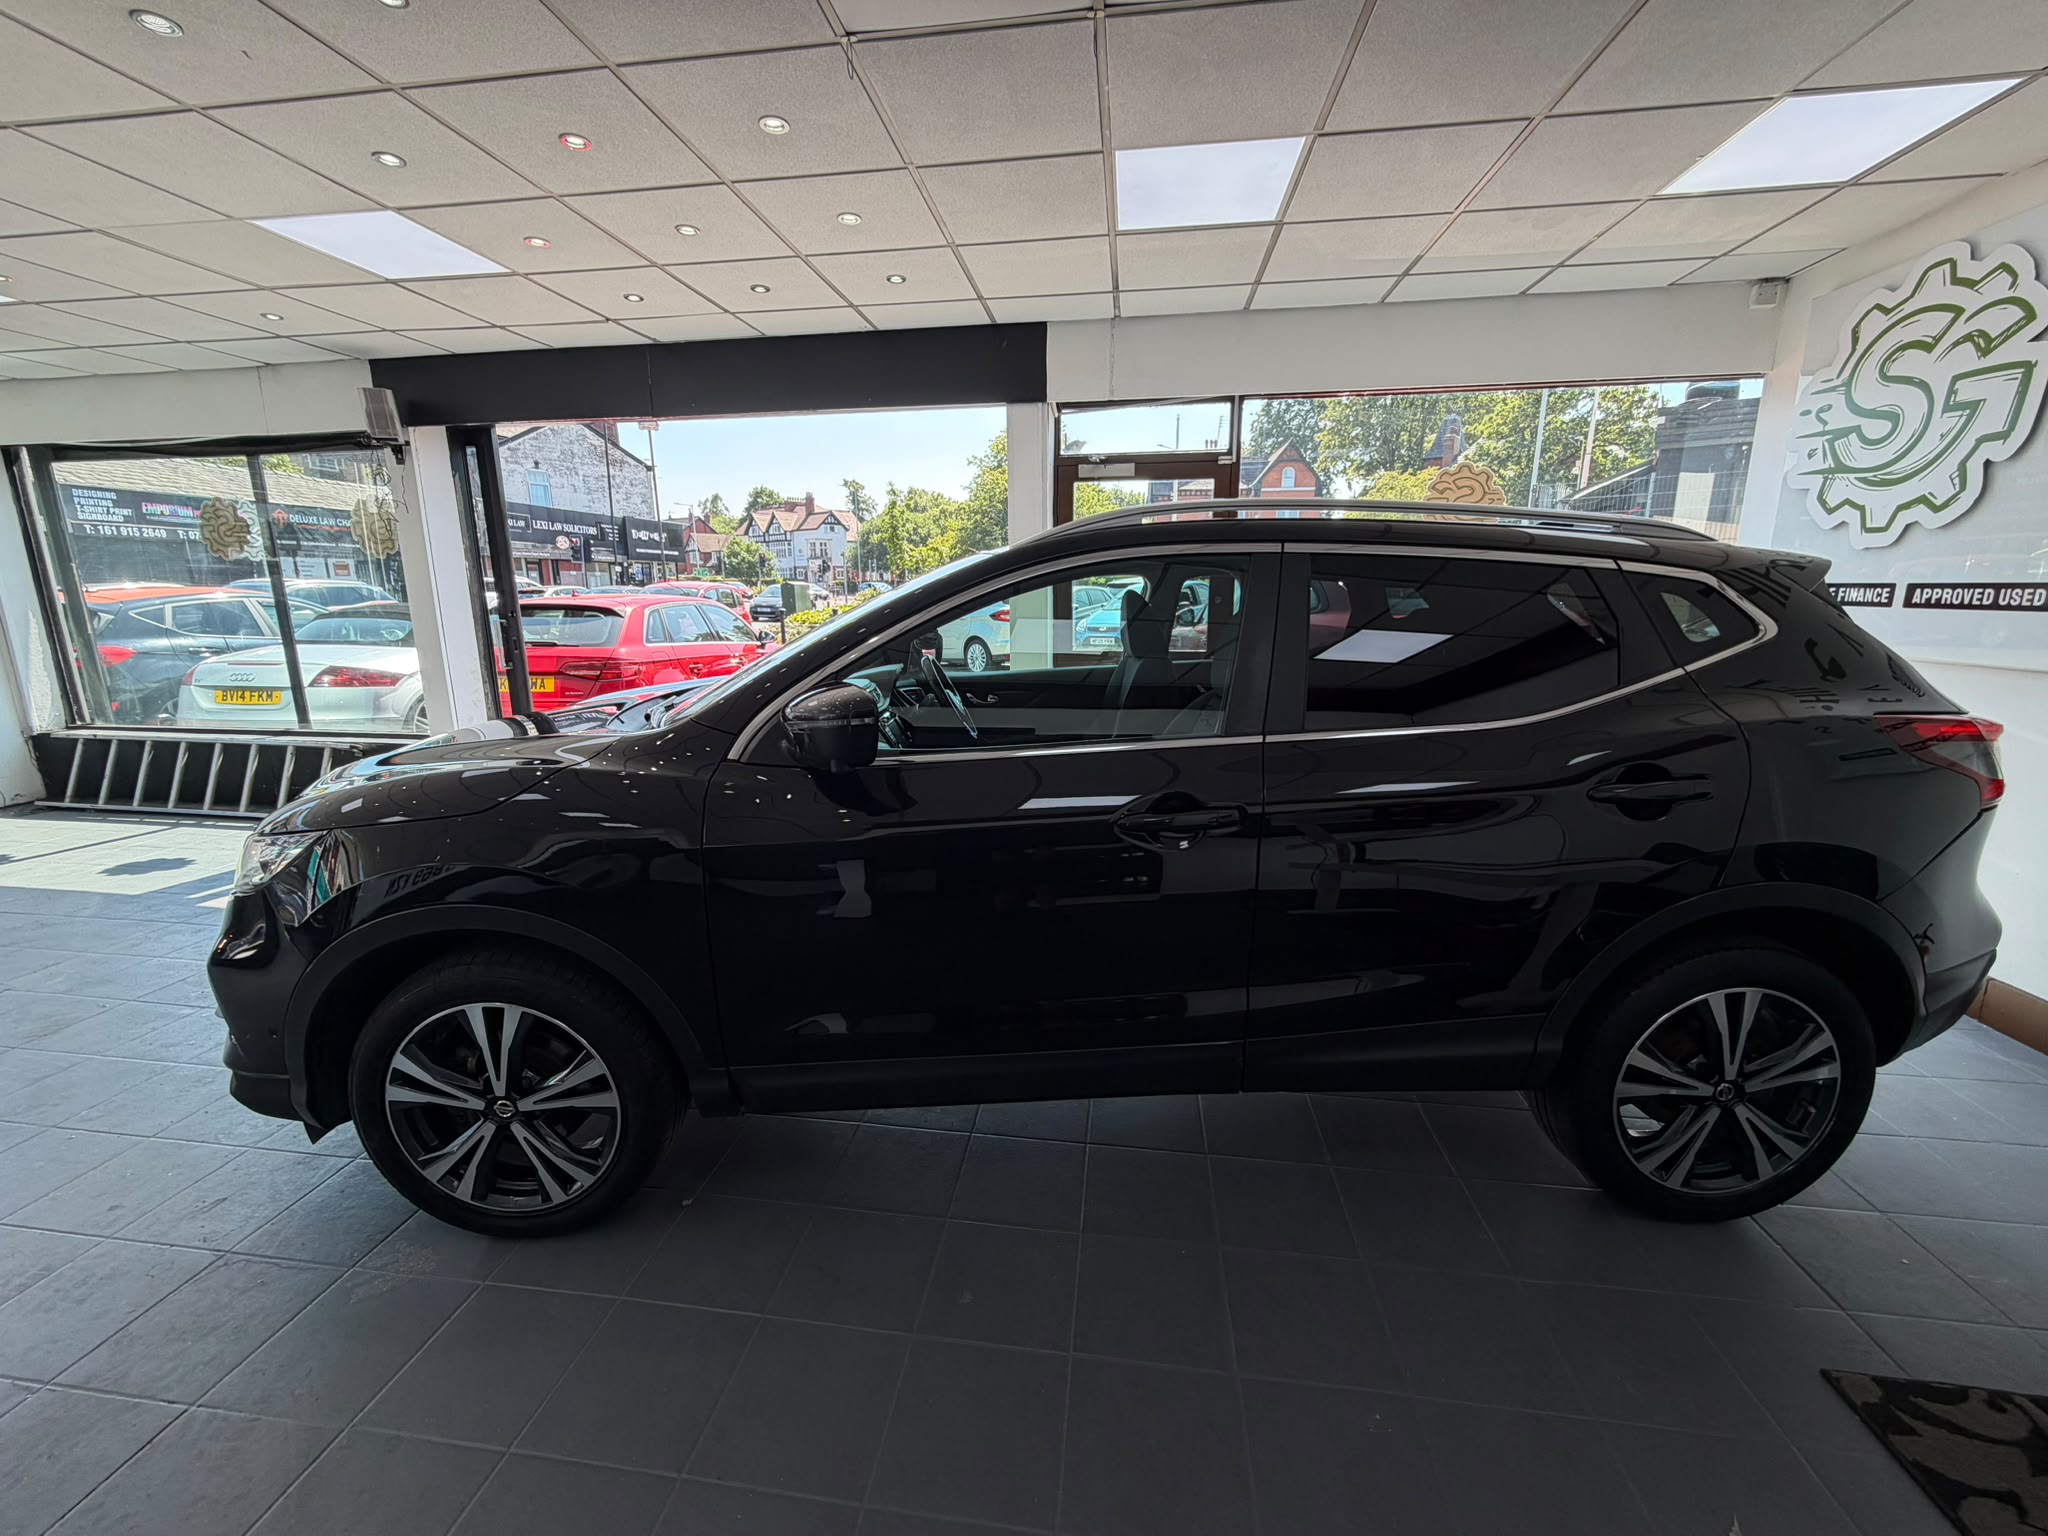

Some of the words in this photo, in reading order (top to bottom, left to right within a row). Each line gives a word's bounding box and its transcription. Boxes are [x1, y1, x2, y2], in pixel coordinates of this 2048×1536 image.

[72, 488, 117, 499] DESIGNING
[73, 497, 113, 507] PRINTING
[75, 505, 108, 515] T-SHIRT
[109, 508, 132, 516] PRINT
[142, 502, 194, 518] EMPORIUM
[77, 512, 124, 522] SIGNBOARD
[289, 514, 318, 525] DELUXE
[319, 517, 336, 526] LAW
[83, 525, 95, 534] T:
[97, 525, 117, 535] 161
[120, 527, 140, 537] 915
[142, 528, 167, 538] 2649
[532, 519, 548, 530] LEXI
[549, 521, 562, 532] LAW
[563, 523, 598, 535] SOLICITORS
[177, 530, 188, 539] T:
[1837, 587, 1891, 603] FINANCE
[1911, 587, 1994, 606] APPROVED
[1998, 588, 2047, 607] USED
[221, 690, 246, 702] BV14
[249, 691, 274, 702] FKM
